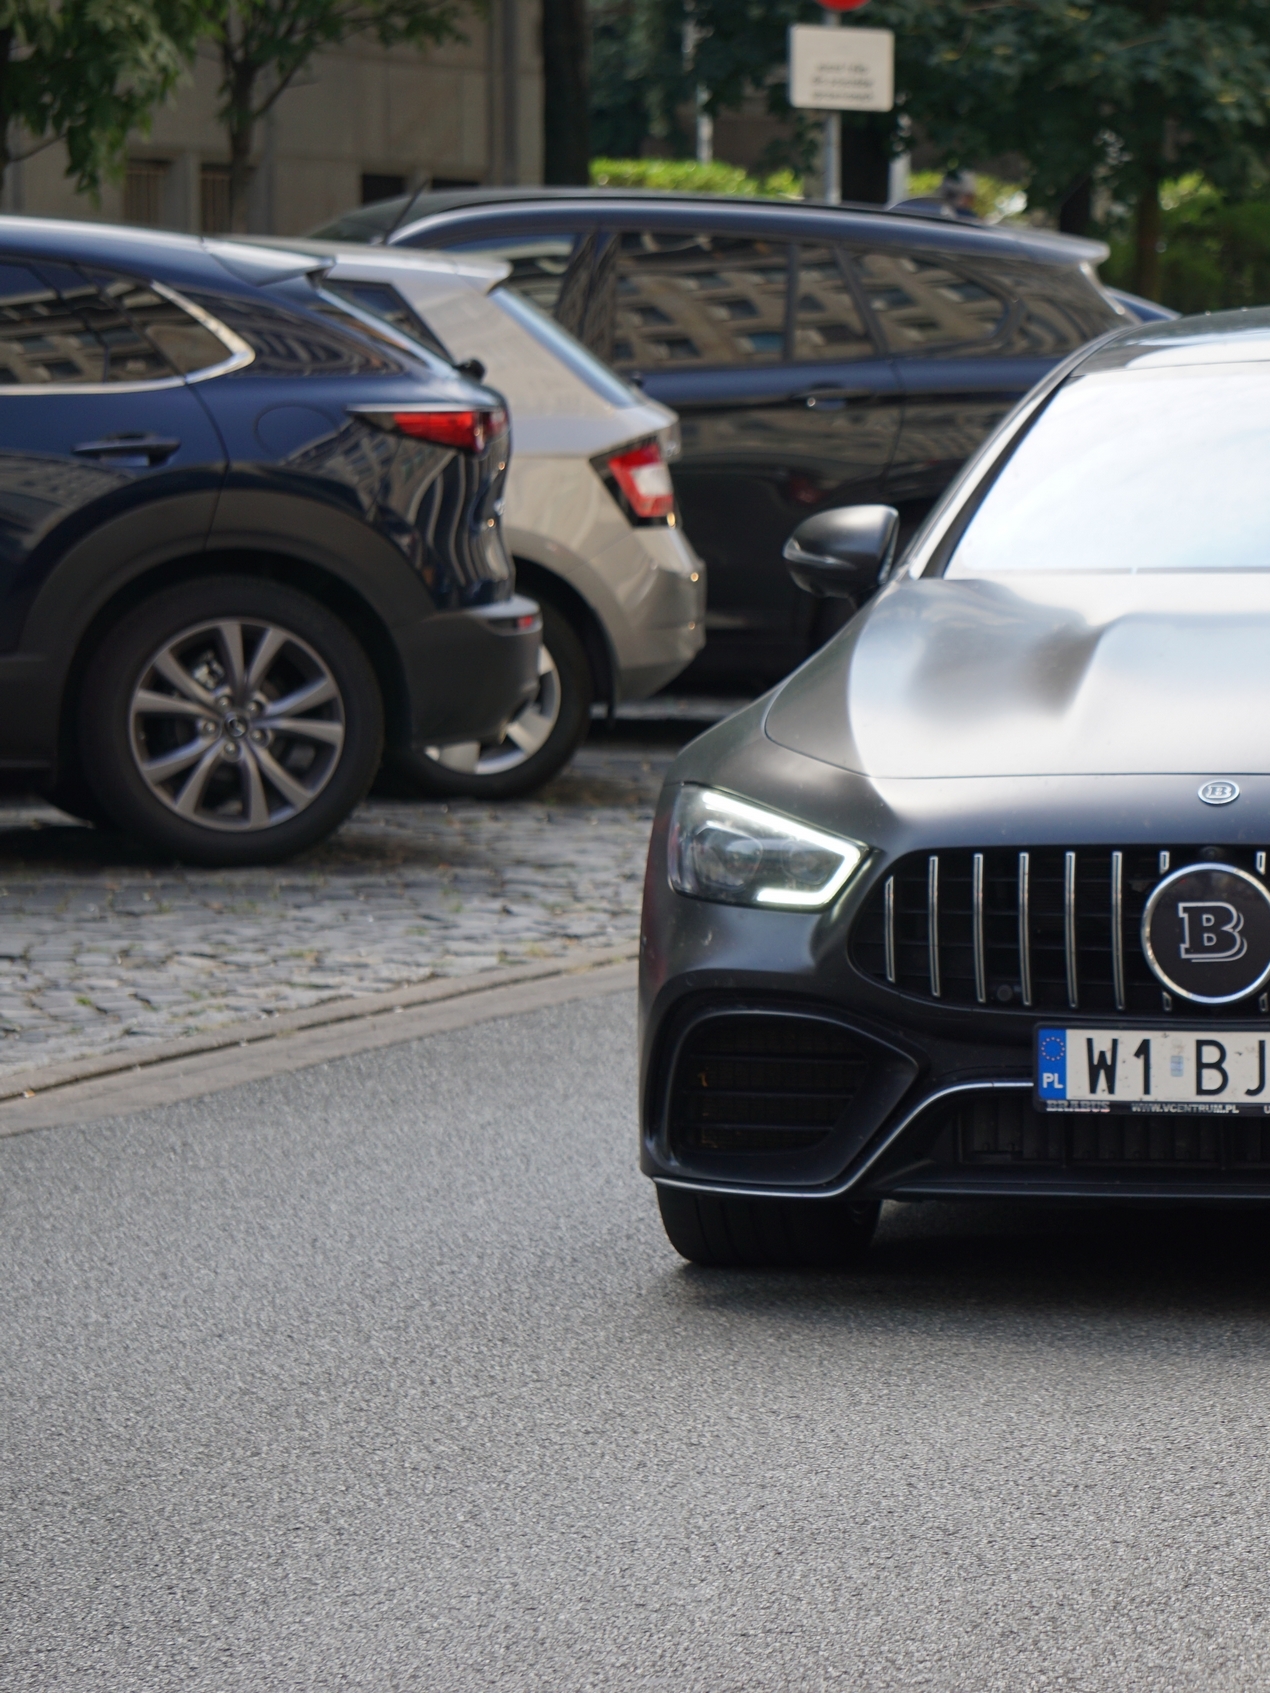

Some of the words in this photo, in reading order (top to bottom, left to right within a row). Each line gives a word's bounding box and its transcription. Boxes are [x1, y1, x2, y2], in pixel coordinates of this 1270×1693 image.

[1178, 901, 1248, 963] B
[1042, 1072, 1064, 1089] PL
[1086, 1037, 1152, 1096] W1
[1046, 1100, 1111, 1113] BRABUS
